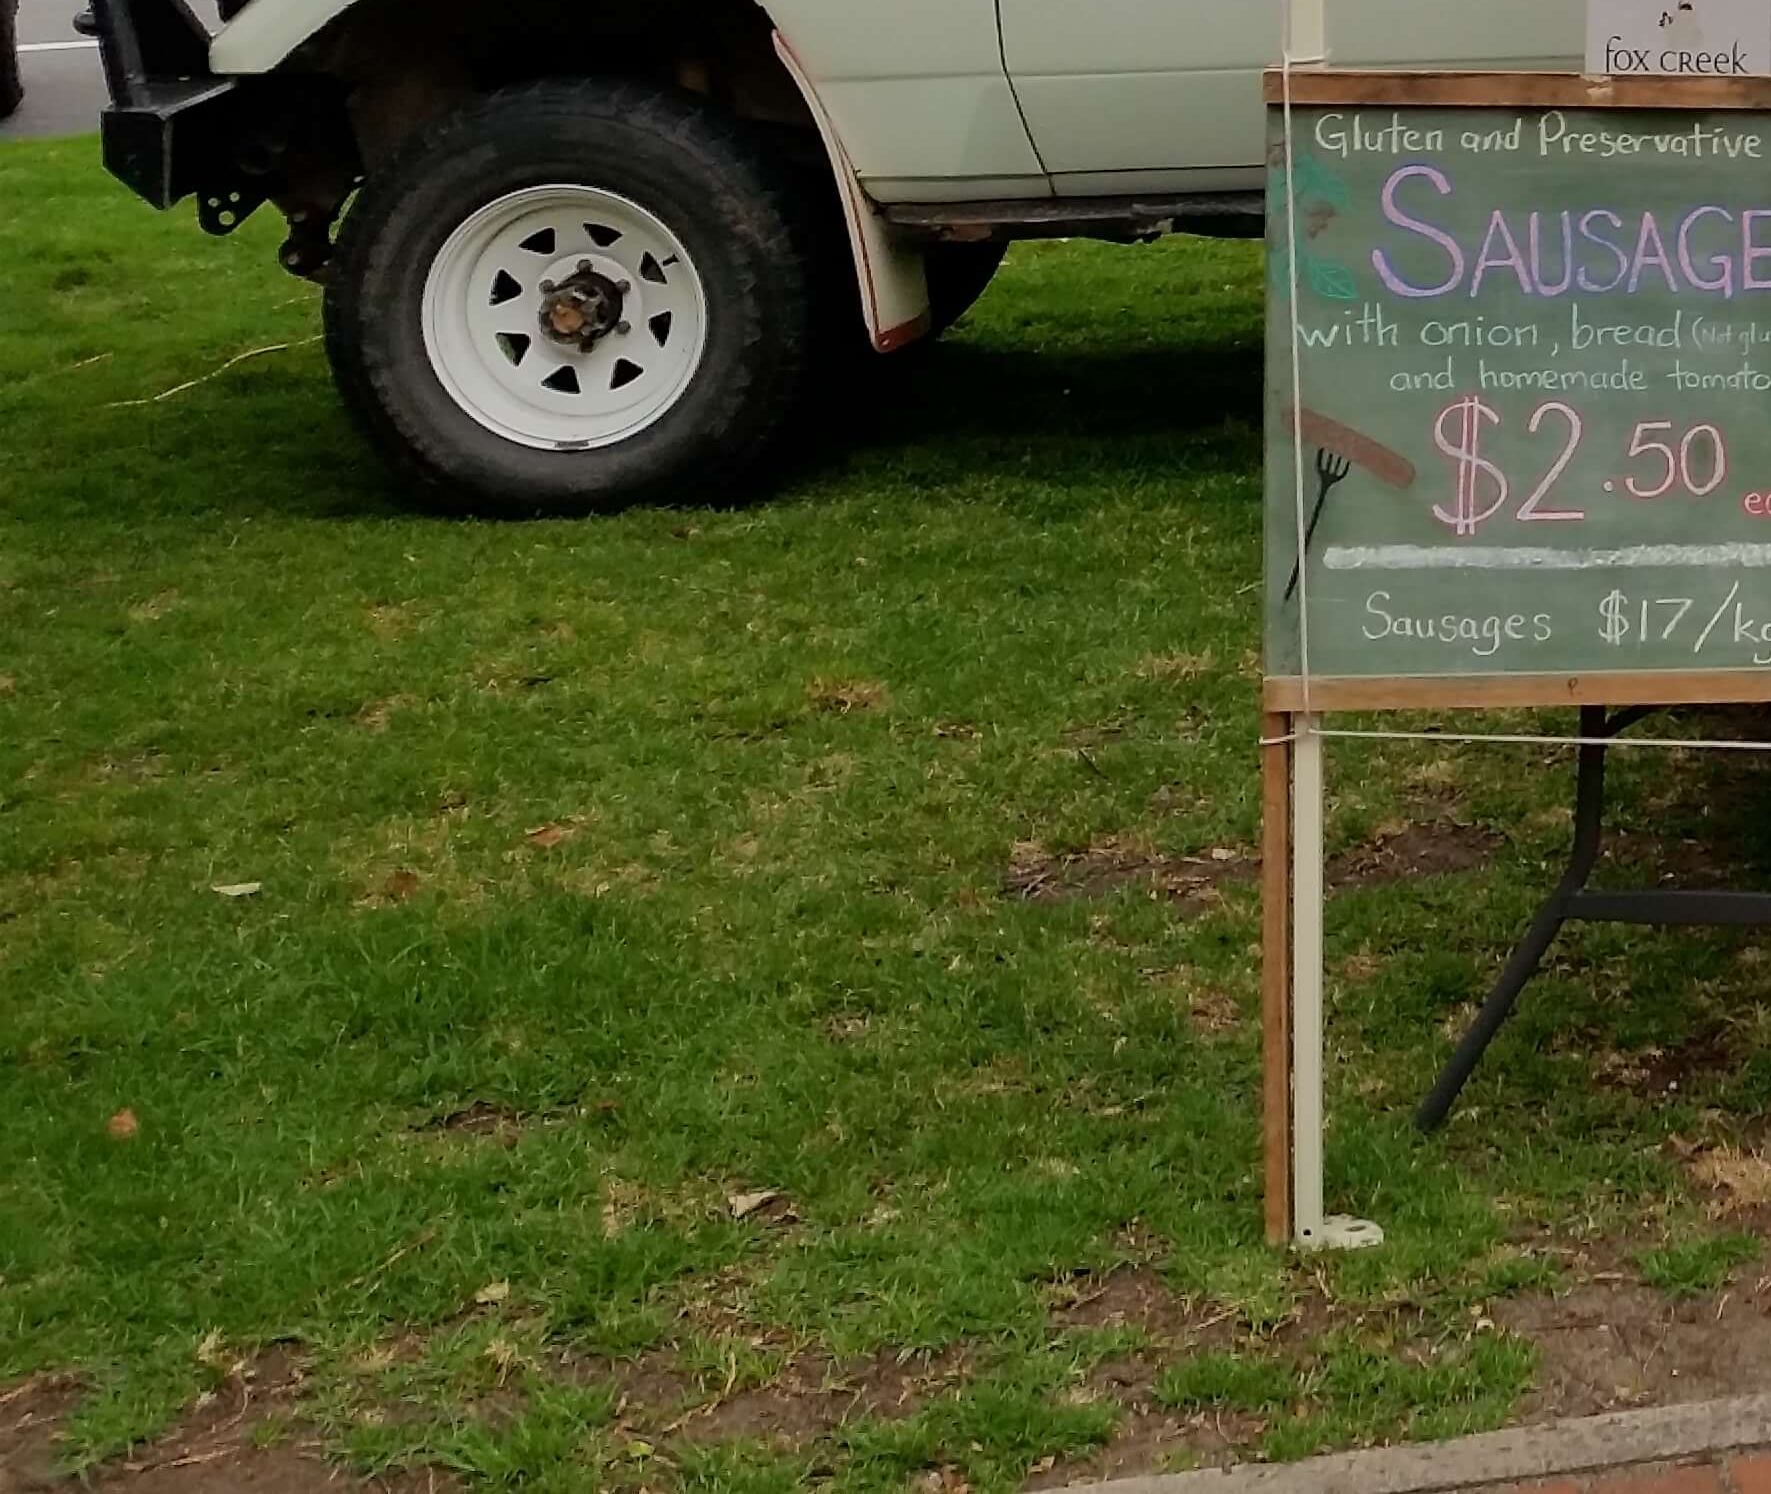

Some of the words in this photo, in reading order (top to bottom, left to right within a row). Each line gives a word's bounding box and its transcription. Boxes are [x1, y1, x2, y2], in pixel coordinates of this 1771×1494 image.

[1605, 35, 1651, 73] fox
[1315, 112, 1444, 158] Gluten
[1460, 118, 1522, 152] and
[1540, 110, 1763, 160] Preservative
[1298, 303, 1400, 348] with
[1419, 322, 1560, 357] onion,
[1571, 303, 1684, 349] bread
[1389, 361, 1456, 392] and
[1479, 357, 1648, 392] homemade
[1431, 395, 1730, 536] $2.50
[1361, 591, 1552, 656] Sausages
